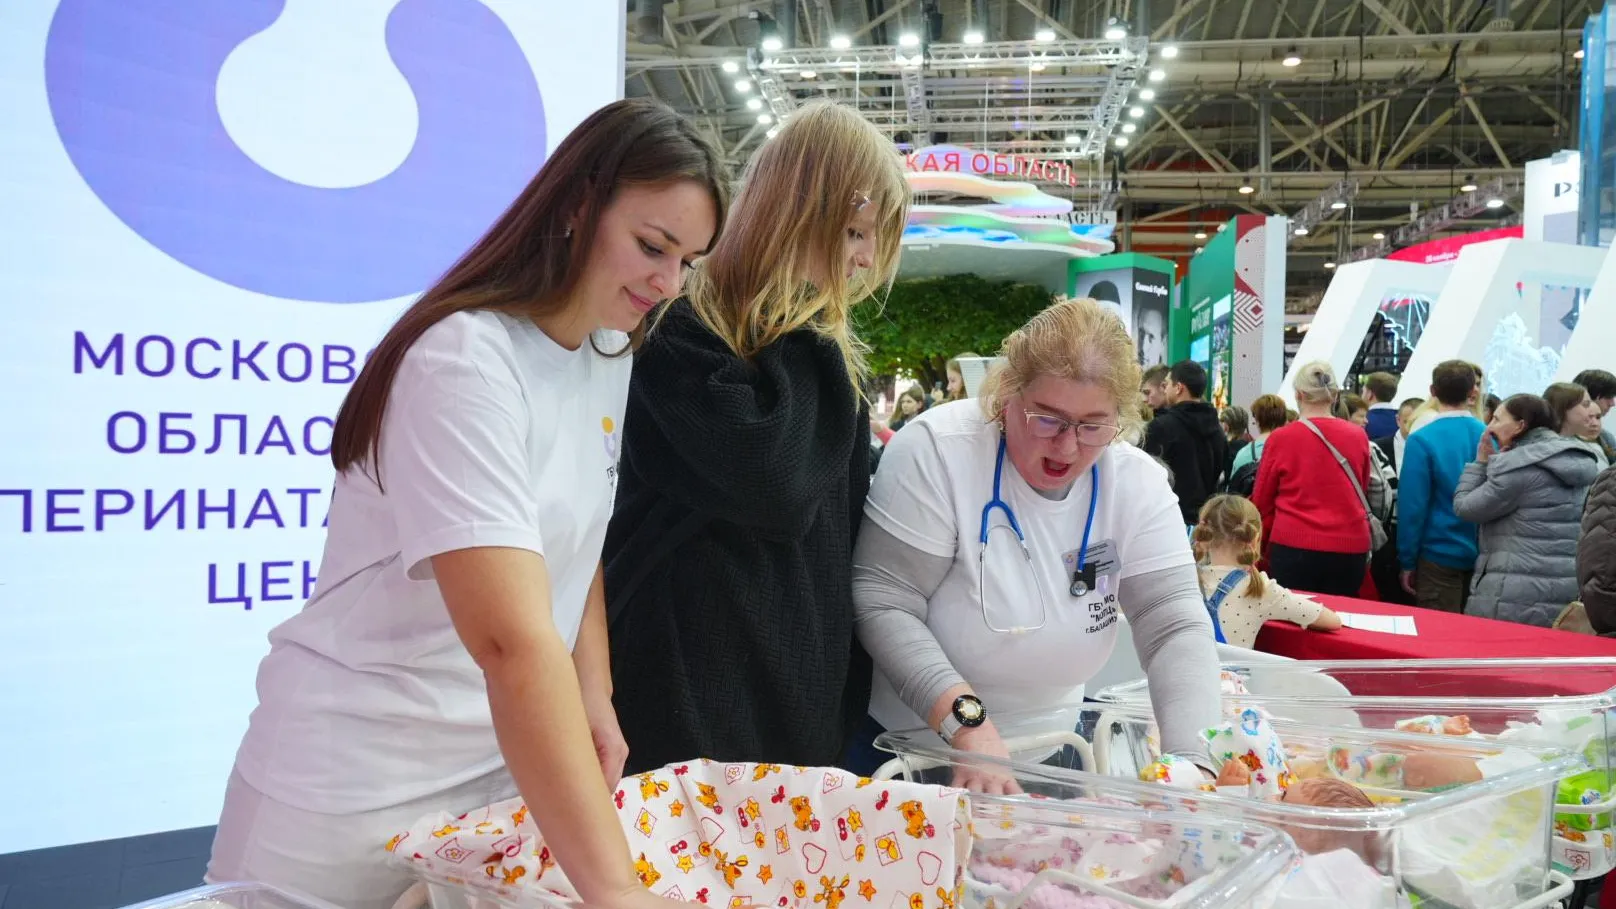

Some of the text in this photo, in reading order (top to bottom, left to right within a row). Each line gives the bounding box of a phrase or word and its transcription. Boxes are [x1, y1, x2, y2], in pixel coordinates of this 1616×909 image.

[971, 153, 1078, 187] ОБЛАСТЬ
[73, 330, 372, 385] МОСКОВ
[0, 488, 329, 533] ПЕРИНАТ
